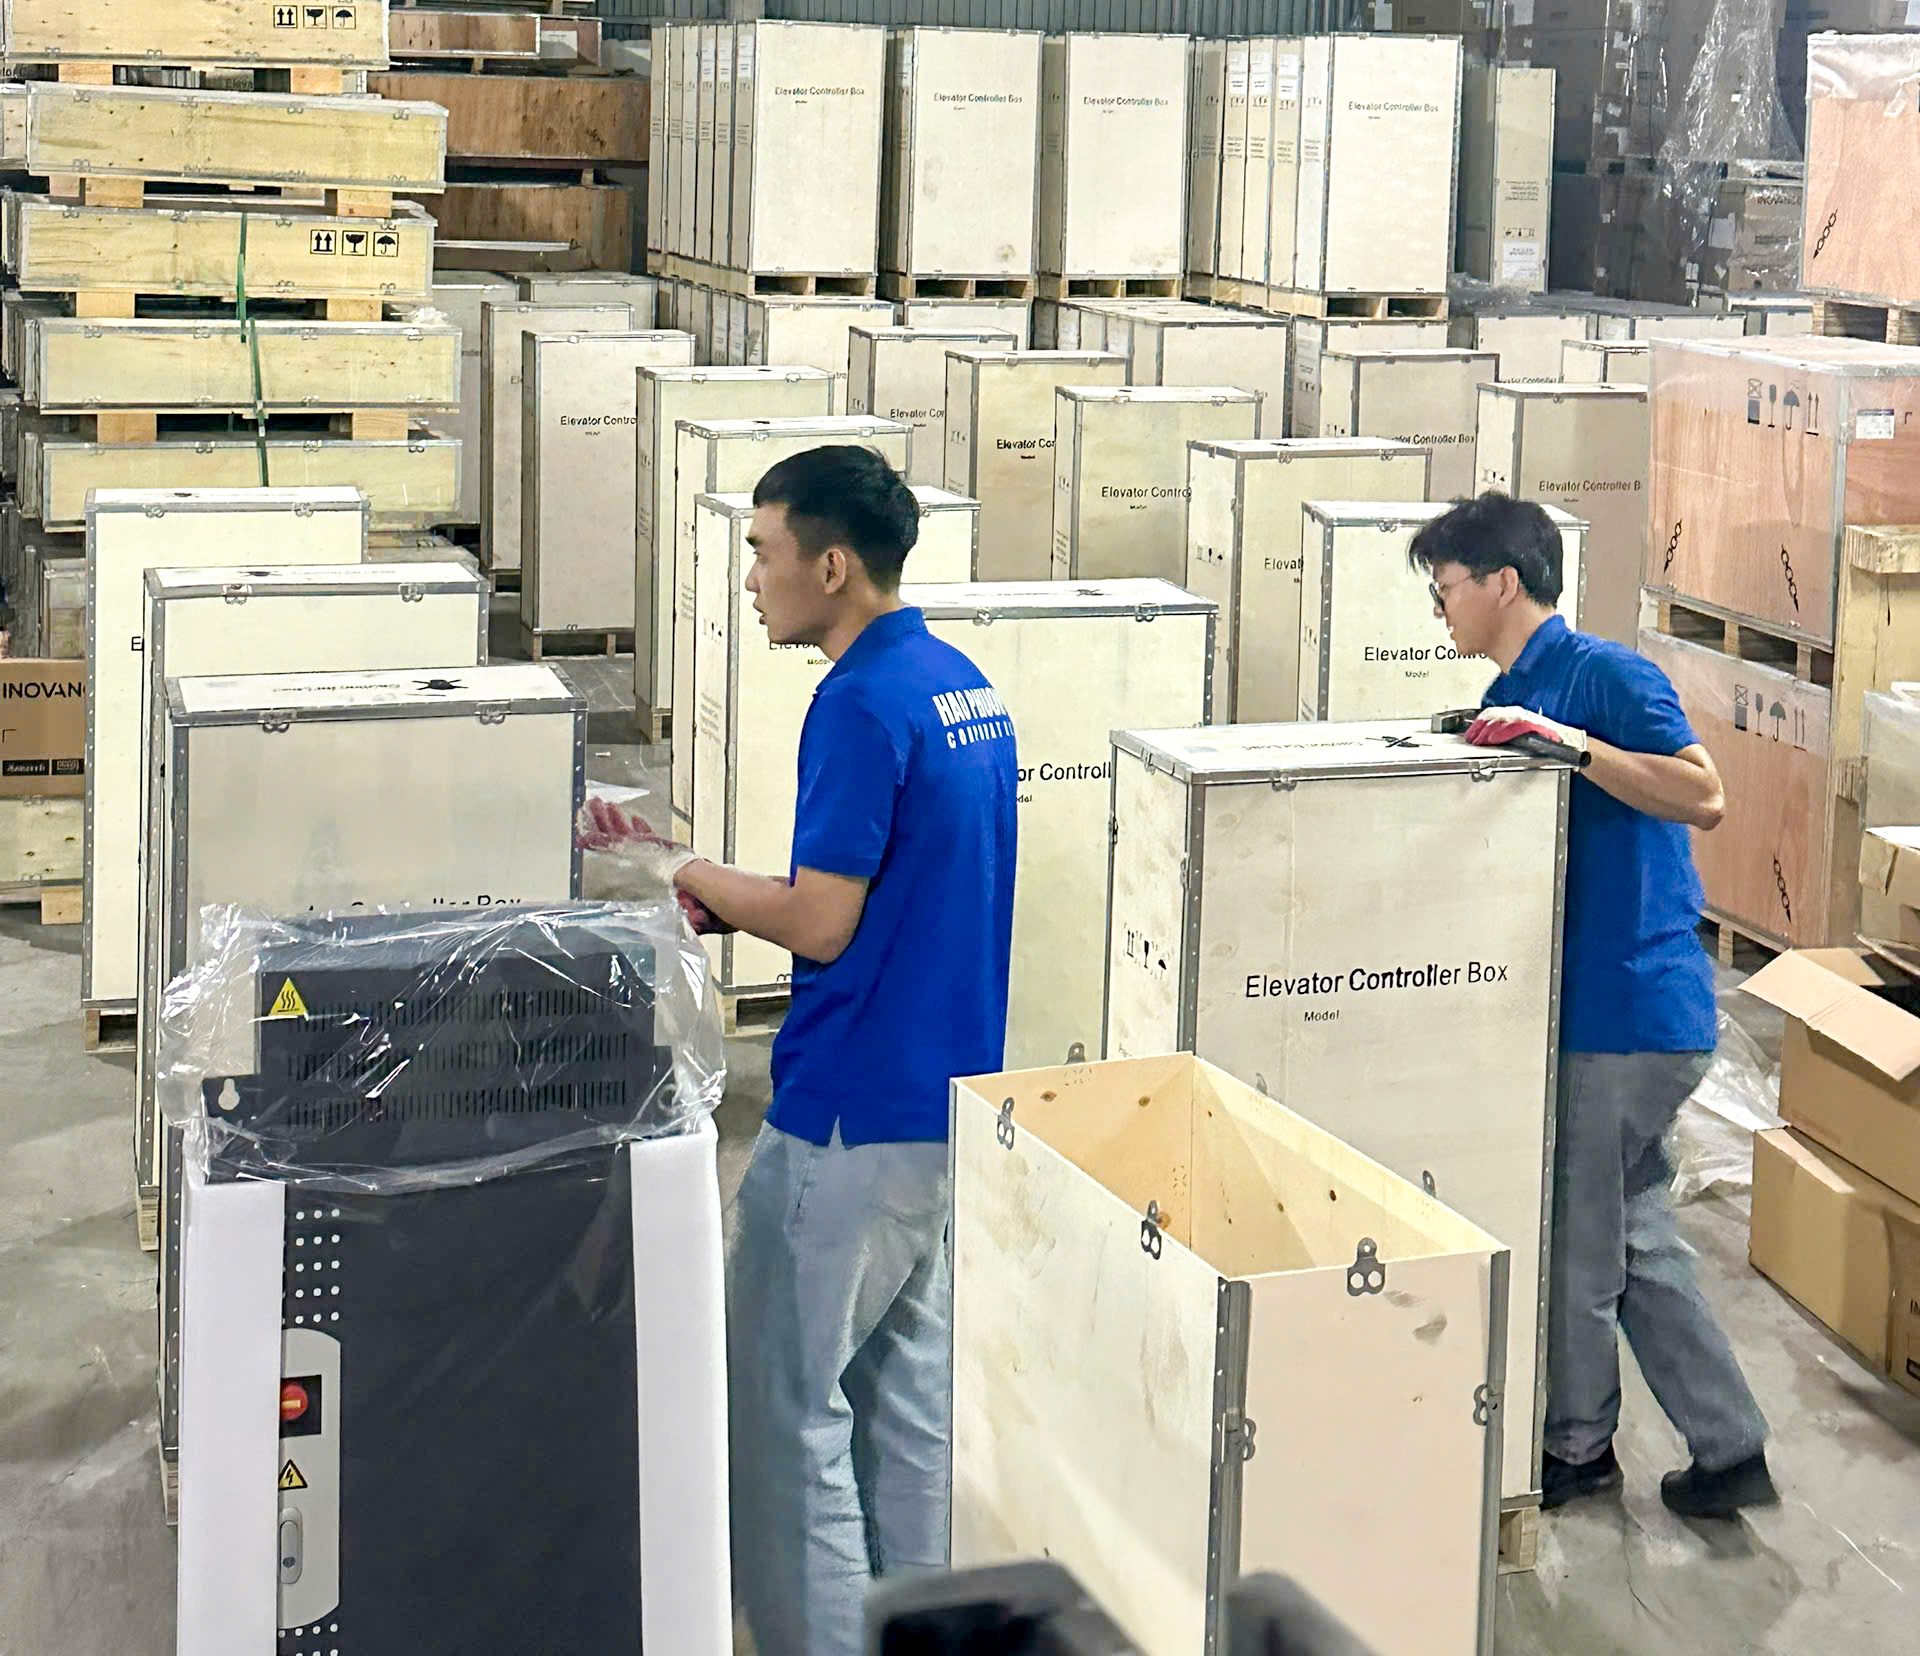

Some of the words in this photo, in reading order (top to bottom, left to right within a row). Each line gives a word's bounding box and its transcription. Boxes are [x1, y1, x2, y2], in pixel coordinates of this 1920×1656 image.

[890, 408, 927, 419] Elevator
[560, 416, 601, 426] Elevator
[996, 439, 1037, 450] Elevator
[1101, 486, 1149, 498] Elevator
[1539, 480, 1581, 492] Elevator
[1582, 480, 1631, 492] Controller
[1364, 646, 1431, 661] Elevator
[3, 681, 86, 699] INOVAN
[1040, 761, 1112, 781] Controll
[1245, 972, 1345, 998] Elevator
[1349, 963, 1462, 992] Controller
[1467, 960, 1509, 984] Box
[1304, 1009, 1340, 1022] Model
